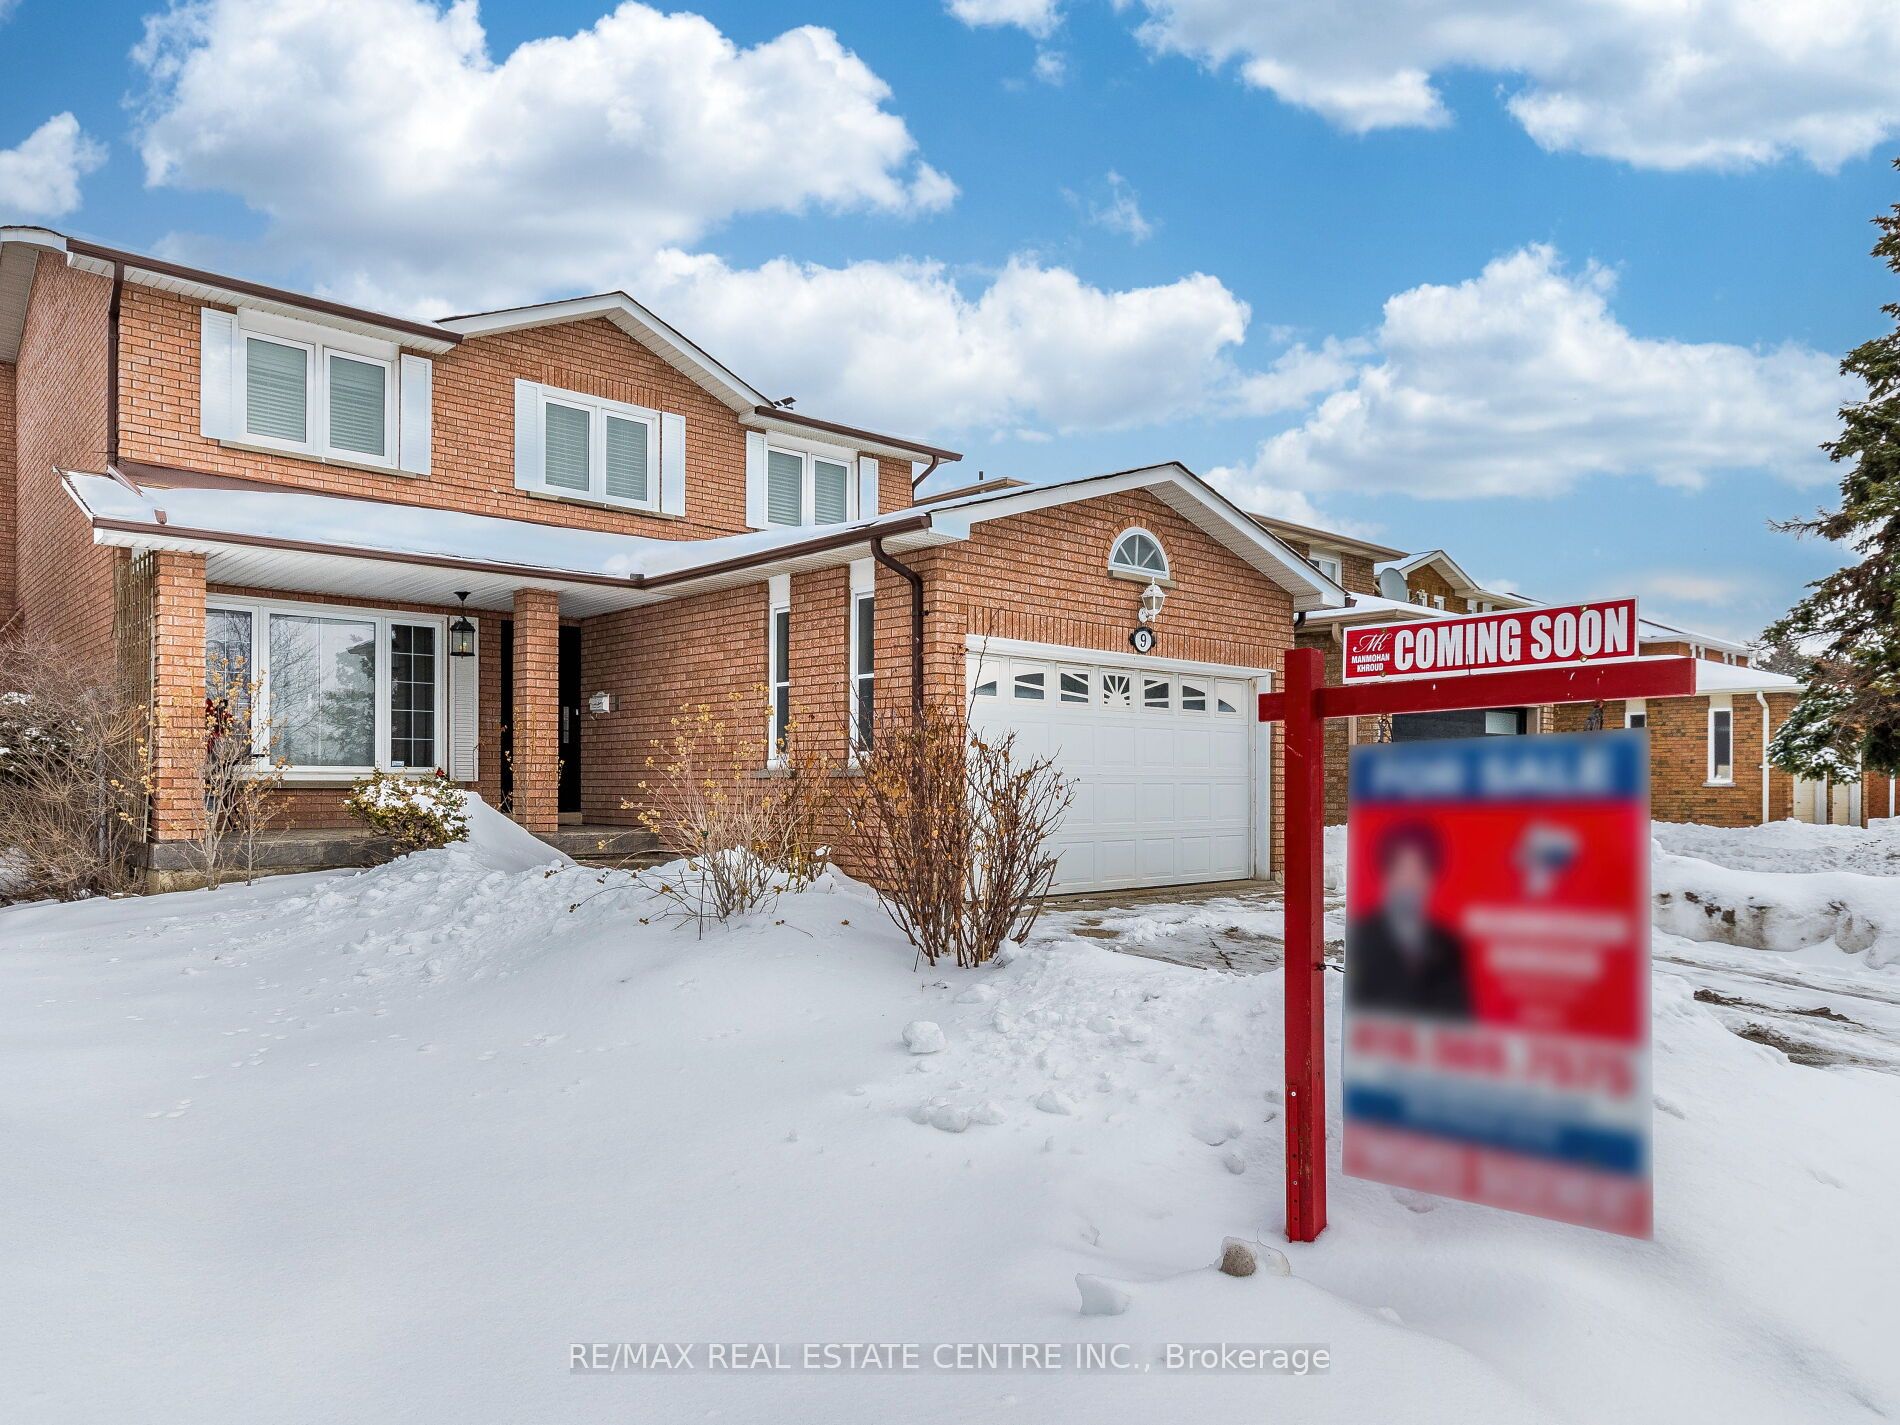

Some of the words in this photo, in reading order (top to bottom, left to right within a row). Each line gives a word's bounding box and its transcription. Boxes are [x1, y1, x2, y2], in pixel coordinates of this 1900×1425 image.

[1140, 633, 1147, 648] 9
[1394, 618, 1521, 671] COMING
[1530, 606, 1628, 658] SOON
[1351, 653, 1390, 664] MANMOHAN
[1356, 662, 1384, 673] KHROUD
